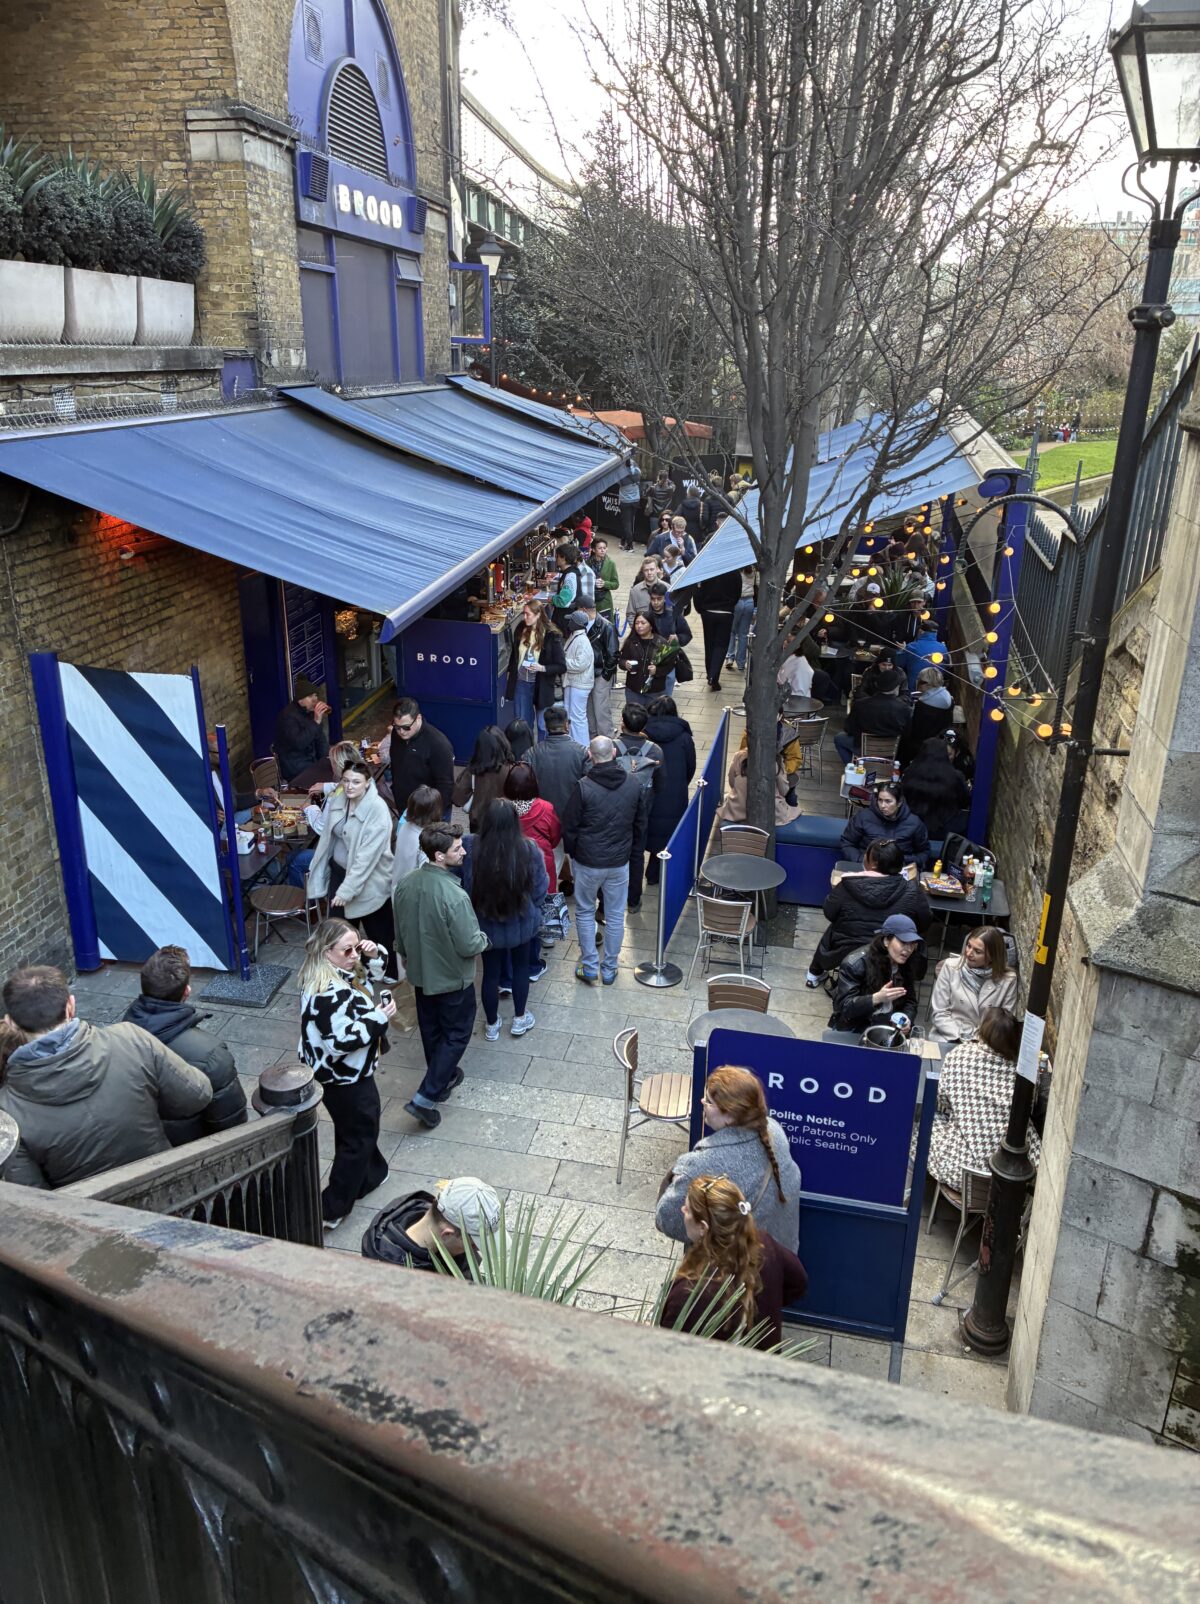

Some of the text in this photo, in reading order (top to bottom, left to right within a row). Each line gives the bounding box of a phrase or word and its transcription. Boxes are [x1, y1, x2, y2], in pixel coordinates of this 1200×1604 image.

[339, 184, 402, 229] BROOD
[416, 652, 478, 666] BROOD
[768, 1072, 887, 1103] ROOD
[769, 1108, 845, 1127] Polite Notice
[780, 1121, 878, 1146] For Patrons Only
[788, 1135, 858, 1154] blic Seating
